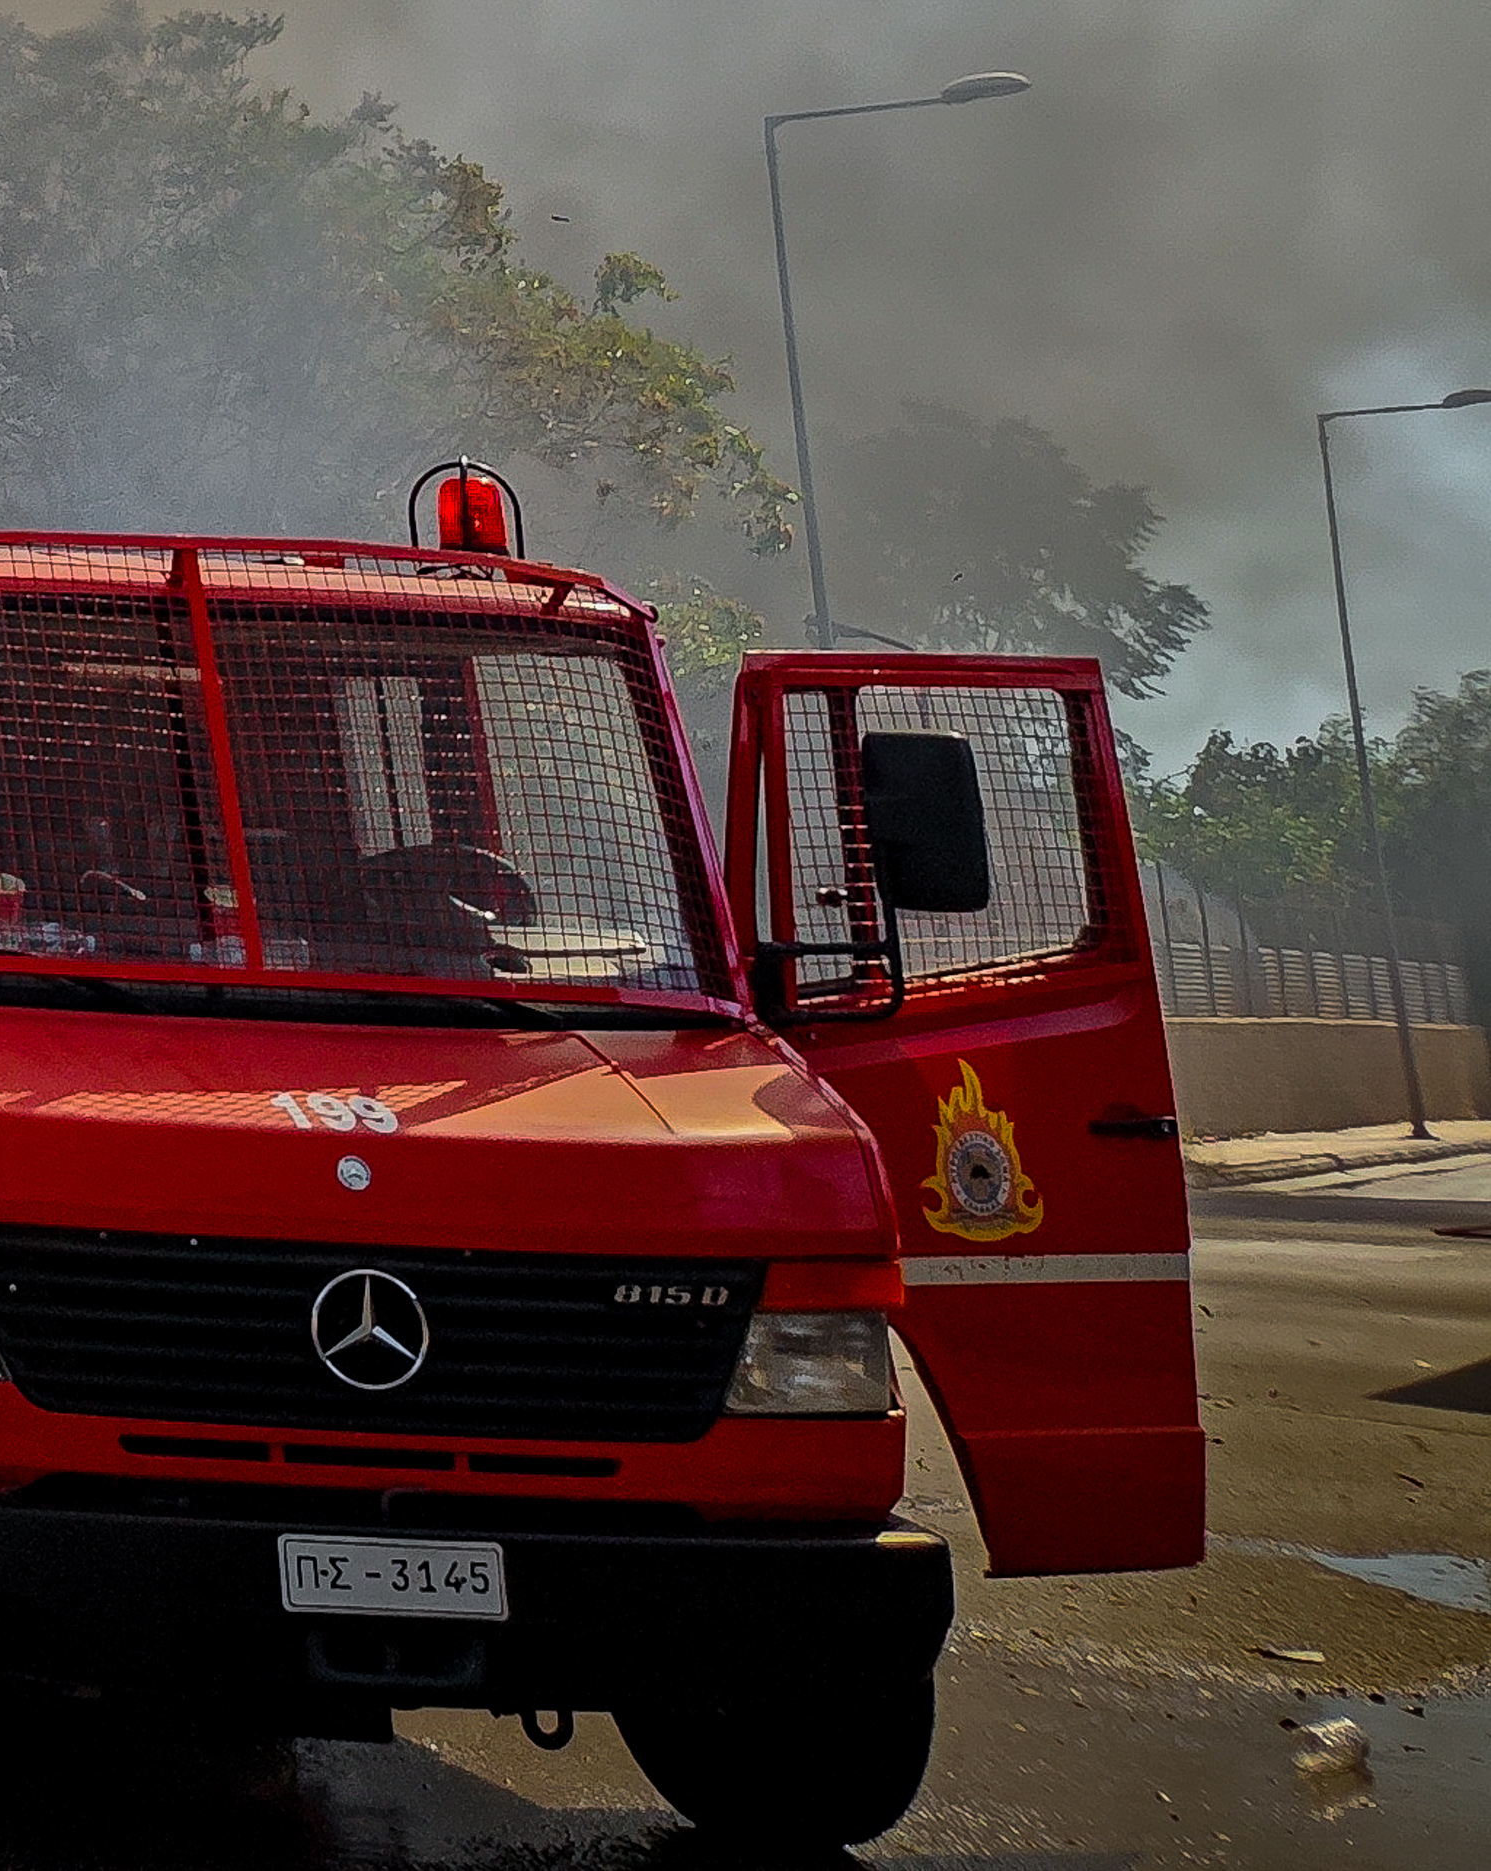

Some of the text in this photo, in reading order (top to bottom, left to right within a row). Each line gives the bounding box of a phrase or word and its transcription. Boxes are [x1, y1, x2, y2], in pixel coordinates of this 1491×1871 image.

[270, 1092, 399, 1134] 199
[614, 1284, 729, 1306] 815 D
